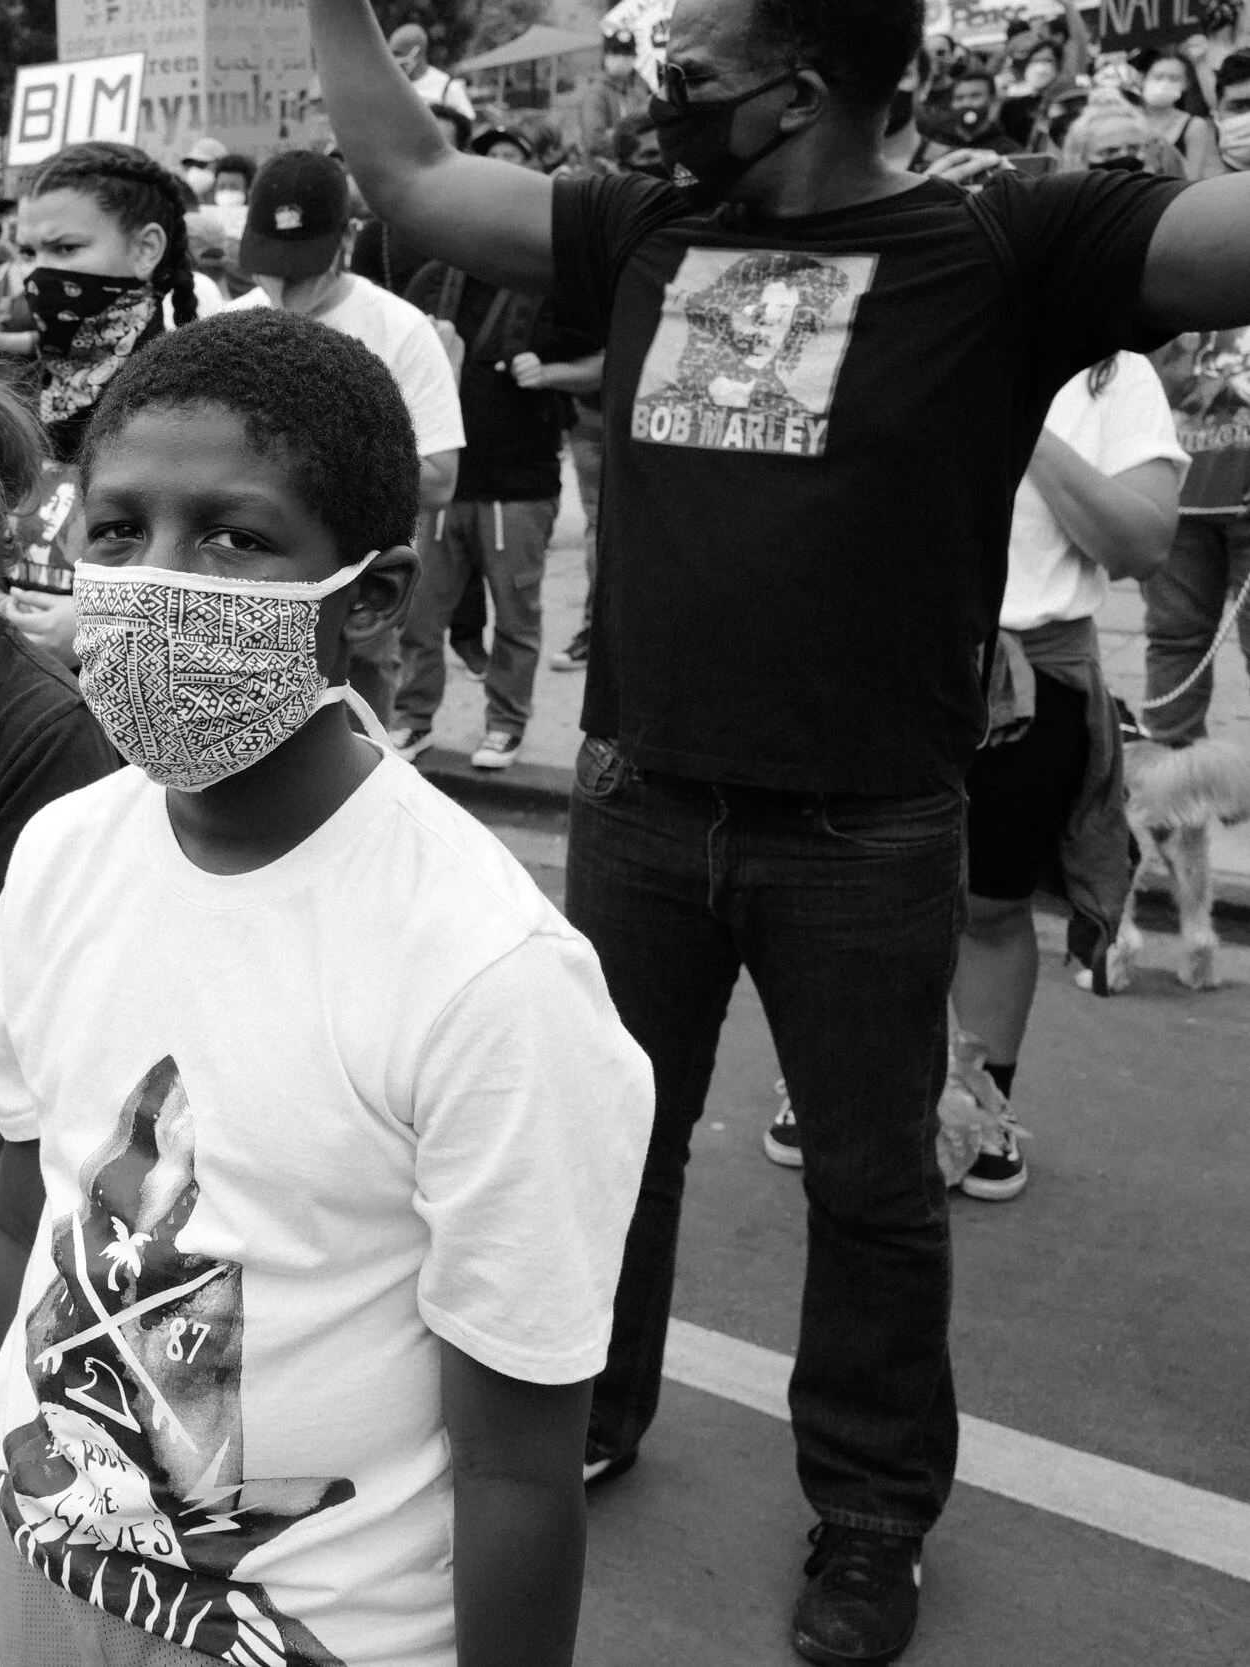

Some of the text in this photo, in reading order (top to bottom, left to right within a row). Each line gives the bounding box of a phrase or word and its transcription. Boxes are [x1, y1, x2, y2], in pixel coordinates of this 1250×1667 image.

[631, 405, 829, 455] BOB MARLEY
[166, 1317, 211, 1364] 87
[82, 1440, 131, 1472] ROCK
